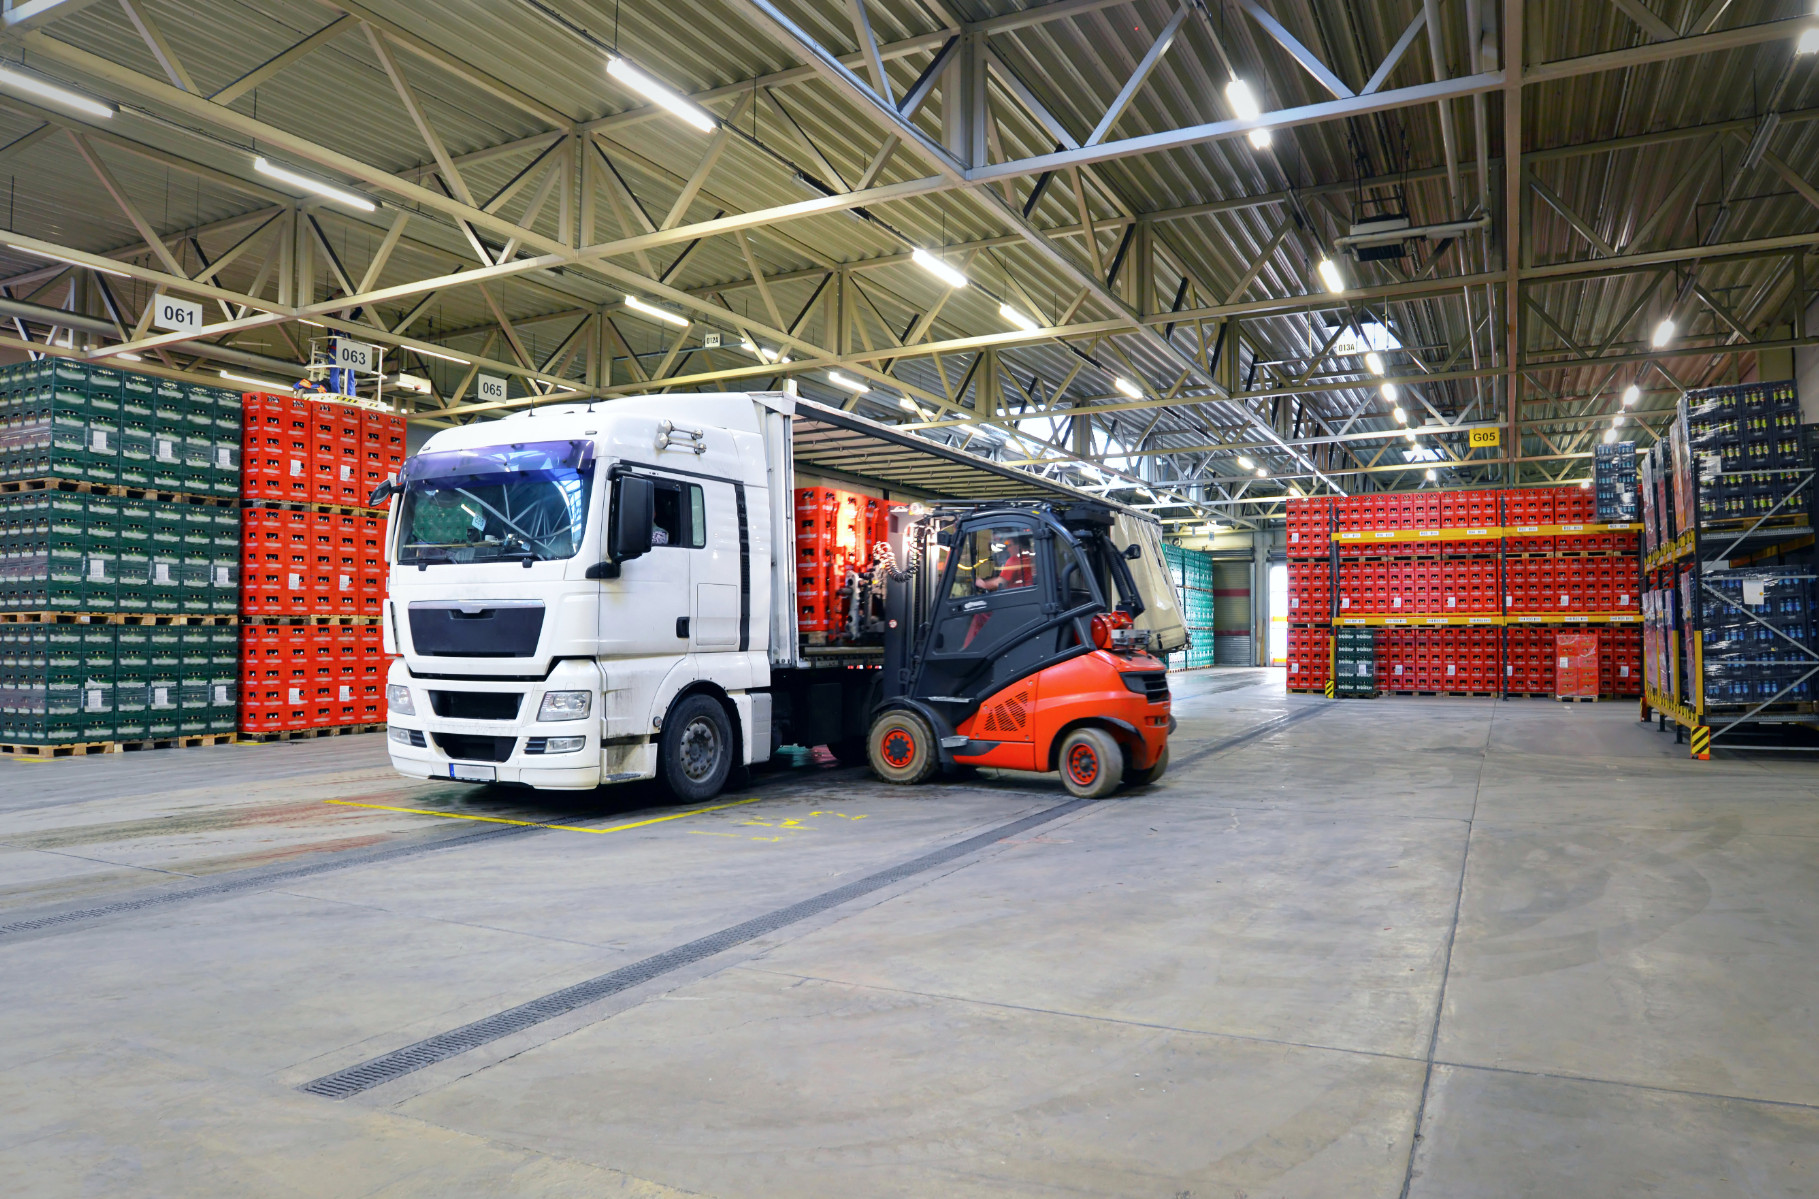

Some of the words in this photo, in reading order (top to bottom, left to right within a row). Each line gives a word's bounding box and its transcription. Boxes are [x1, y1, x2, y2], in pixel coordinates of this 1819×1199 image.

[164, 305, 194, 325] 061
[342, 348, 366, 365] 063
[482, 382, 502, 396] 065
[1473, 432, 1496, 442] G05
